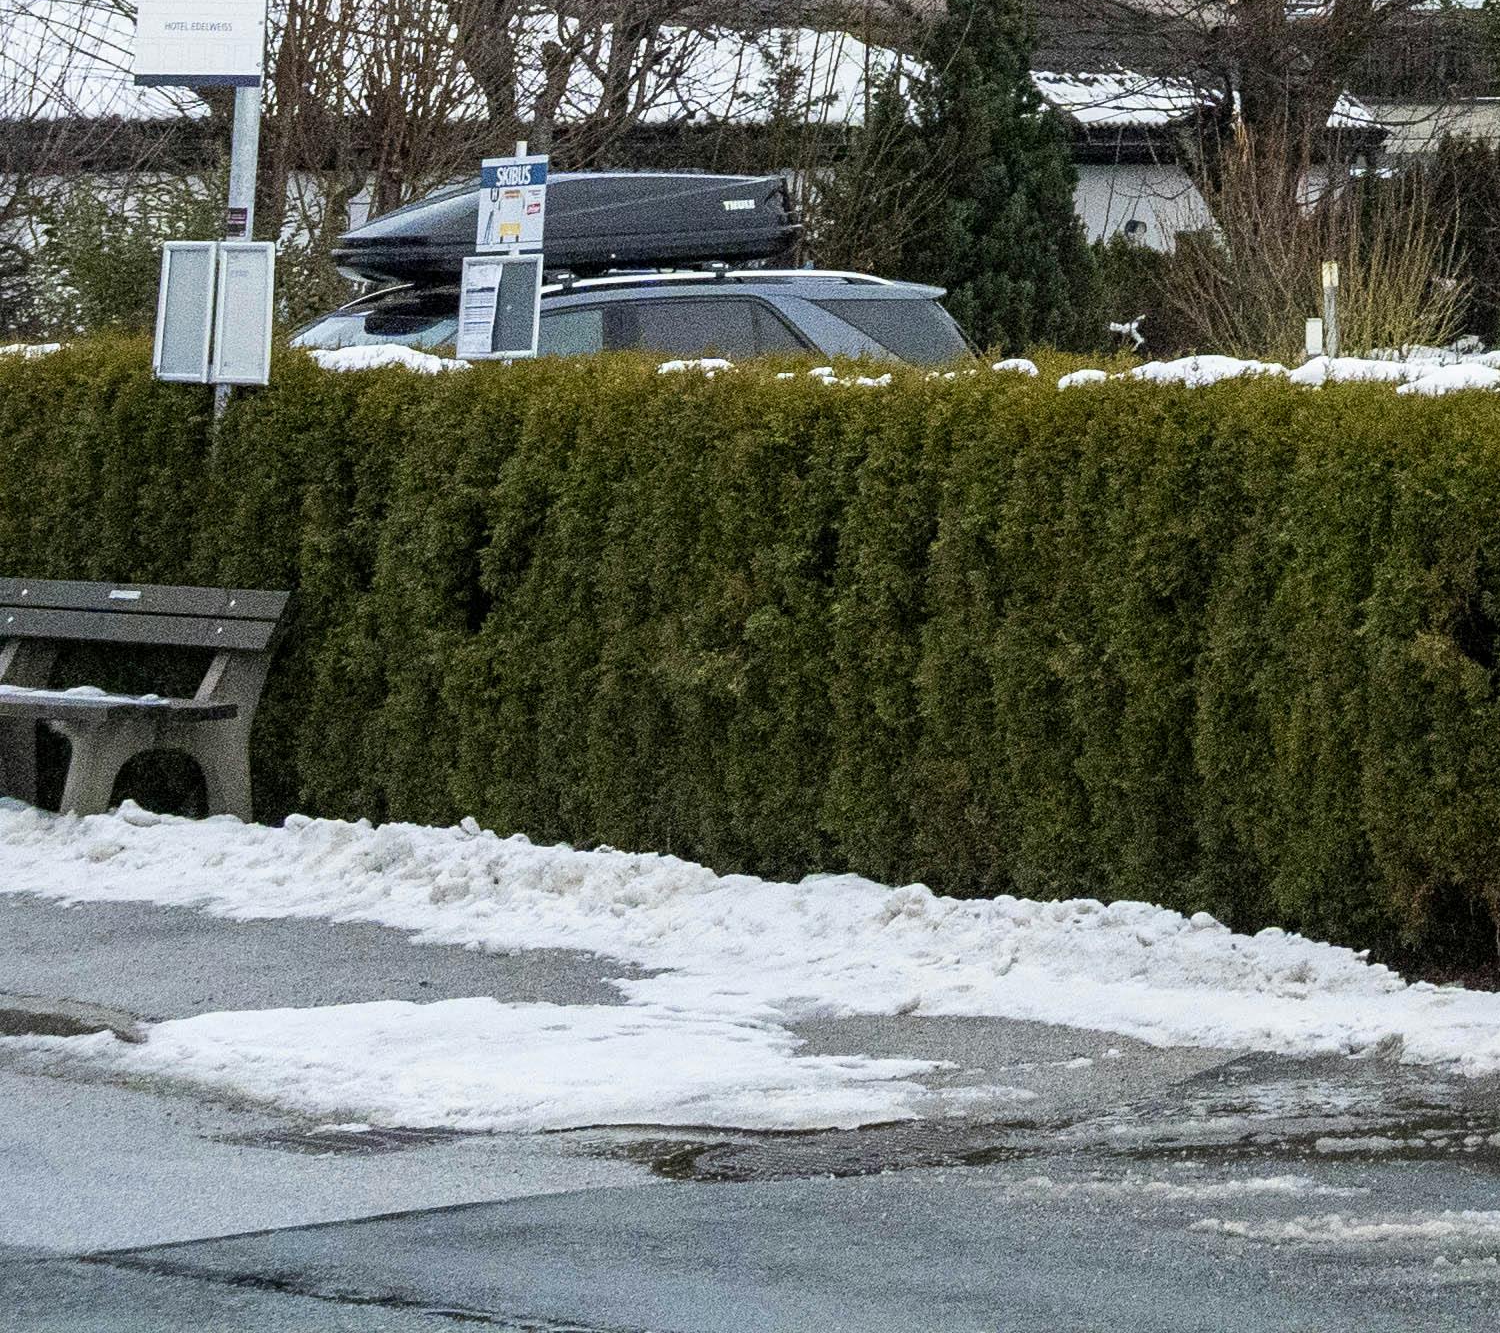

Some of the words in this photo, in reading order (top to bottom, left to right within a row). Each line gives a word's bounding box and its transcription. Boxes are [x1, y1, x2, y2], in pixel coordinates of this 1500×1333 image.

[164, 20, 188, 31] HOTEL
[190, 21, 233, 32] EDELWEISS
[496, 164, 531, 186] SKIBUS
